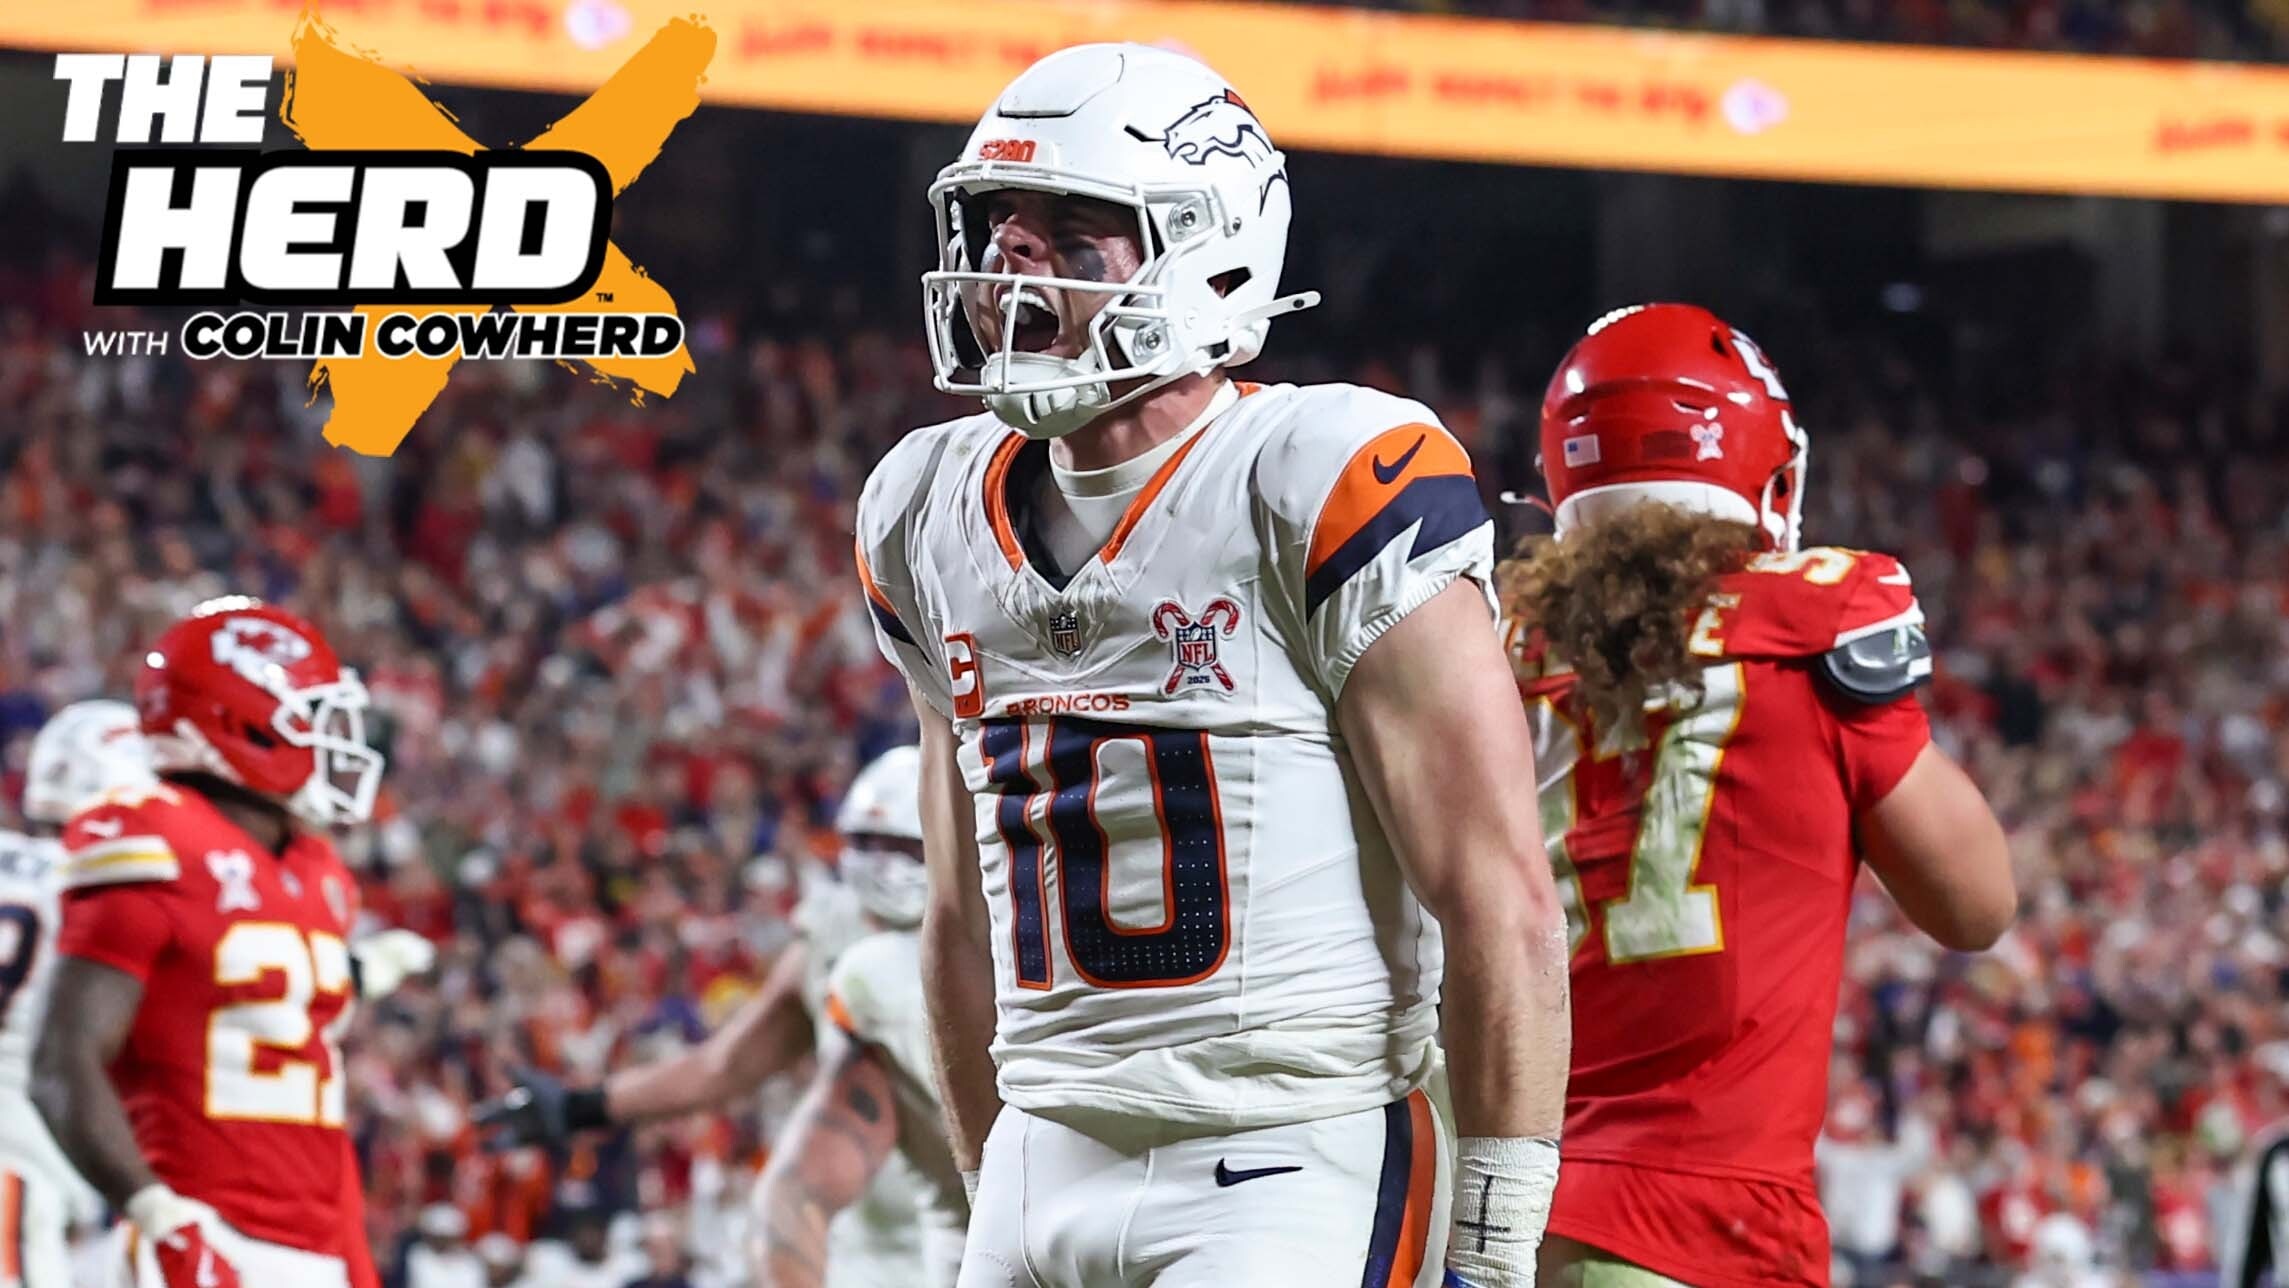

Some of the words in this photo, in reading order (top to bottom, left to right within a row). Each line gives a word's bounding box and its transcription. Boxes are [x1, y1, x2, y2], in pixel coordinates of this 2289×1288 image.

[1055, 631, 1080, 651] NFL
[1181, 642, 1214, 665] NFL
[980, 718, 1231, 990] 10
